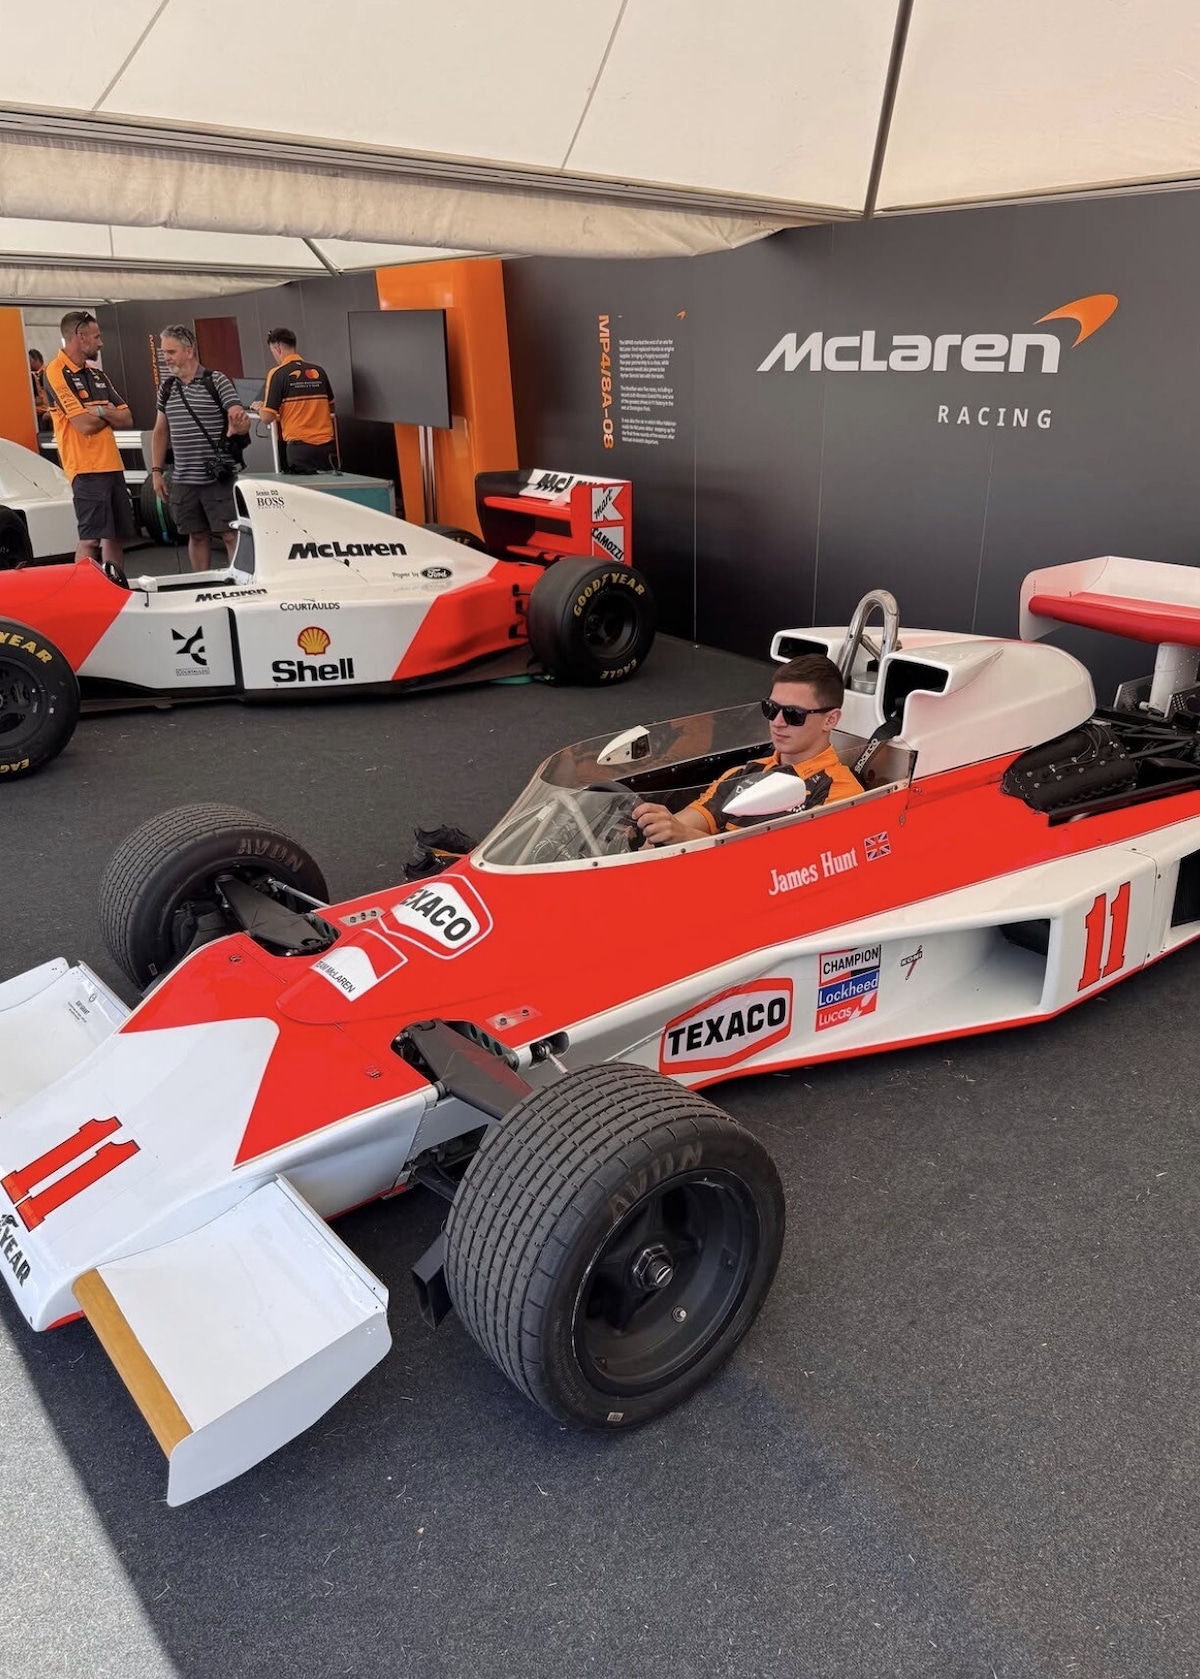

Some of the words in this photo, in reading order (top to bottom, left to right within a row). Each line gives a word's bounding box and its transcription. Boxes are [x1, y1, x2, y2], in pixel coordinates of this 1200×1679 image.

[756, 330, 1061, 373] McLaren
[937, 405, 1052, 428] RACING
[256, 497, 285, 507] BOSS
[288, 541, 407, 560] McLaren
[425, 568, 449, 578] Ford
[195, 588, 267, 602] McLaren
[279, 602, 340, 611] COURTAULDS
[272, 658, 355, 682] Shell
[600, 659, 637, 679] EAGLE
[768, 864, 819, 896] James
[820, 847, 858, 878] Hunt
[400, 888, 471, 941] EXACO
[1077, 881, 1131, 992] 11
[823, 947, 879, 975] CHAMPION
[819, 972, 879, 1006] Lockheed
[668, 997, 786, 1056] TEXACO
[0, 1116, 141, 1232] 11
